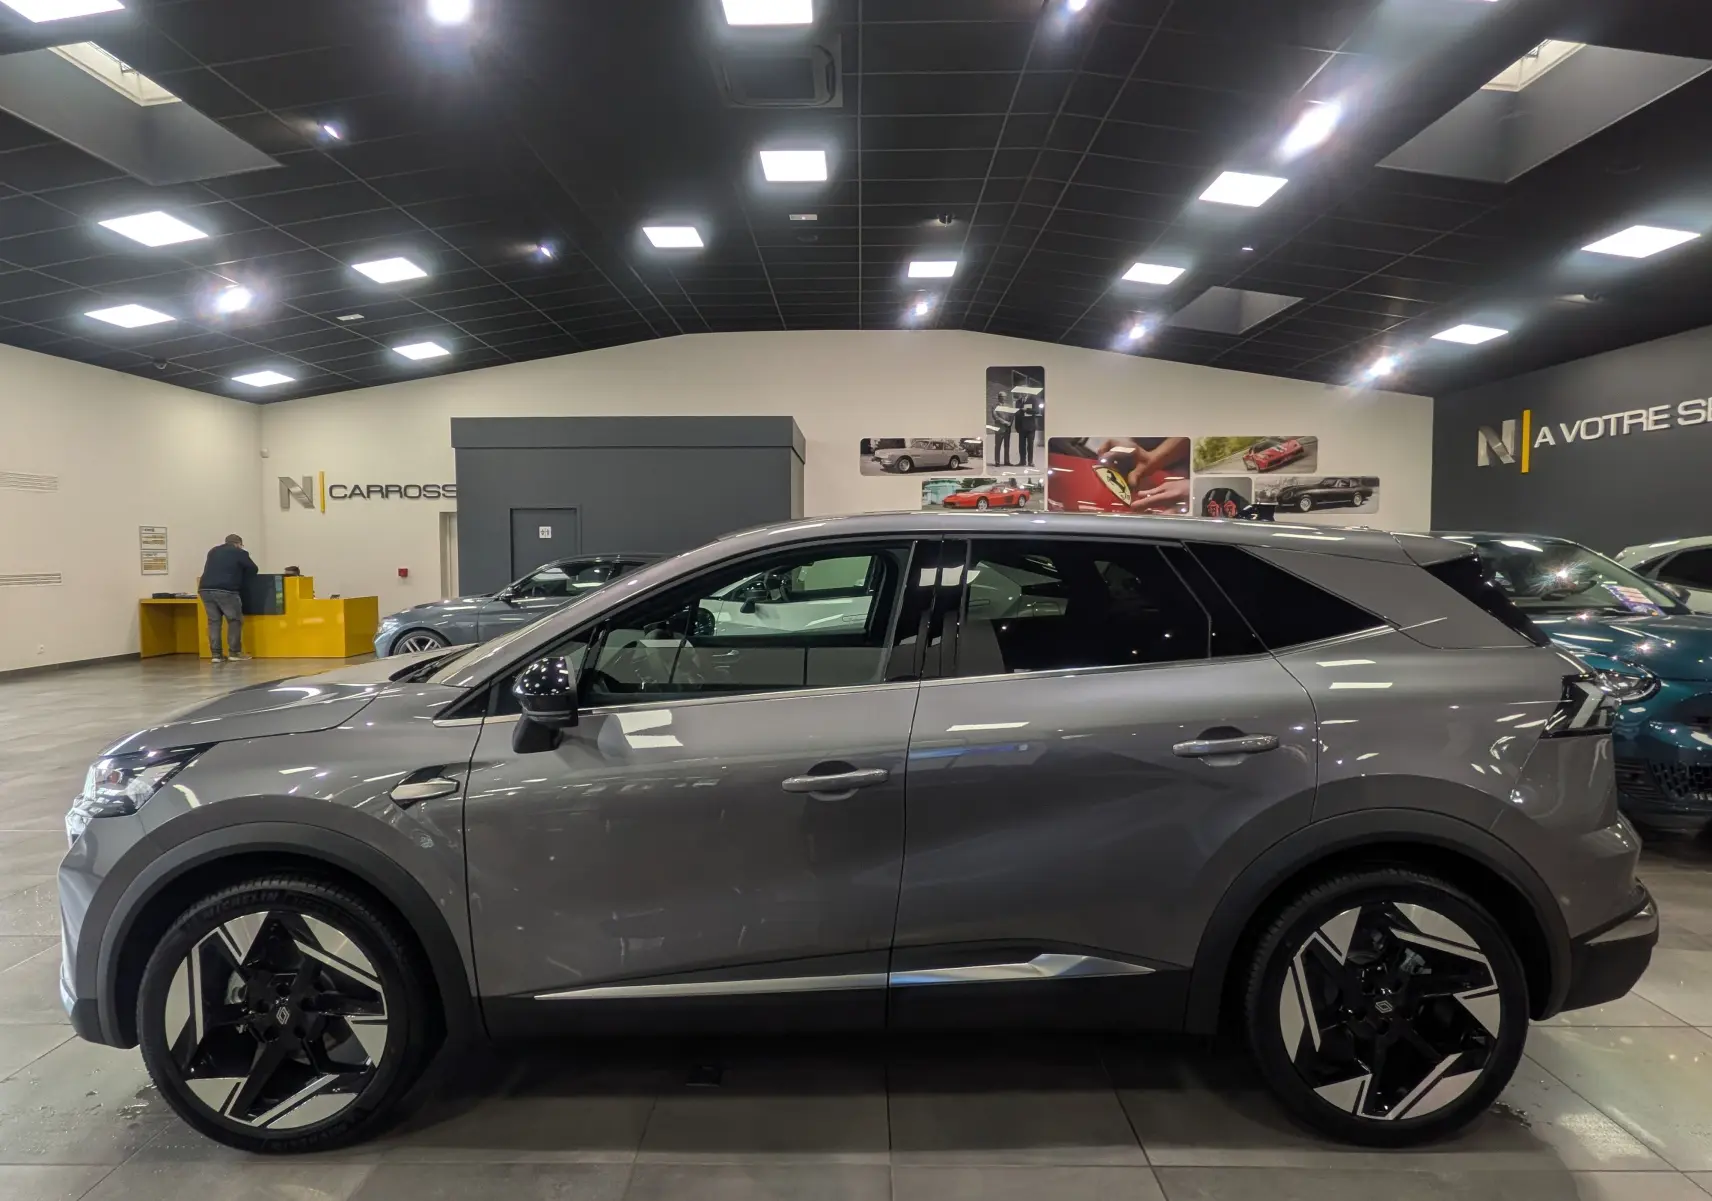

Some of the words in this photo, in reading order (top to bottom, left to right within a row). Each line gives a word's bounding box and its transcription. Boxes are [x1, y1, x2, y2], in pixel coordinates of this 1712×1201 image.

[1533, 426, 1557, 448] A
[1560, 404, 1671, 444] VOTRE
[328, 484, 457, 500] CARROSS
[203, 891, 278, 918] MICHELIN
